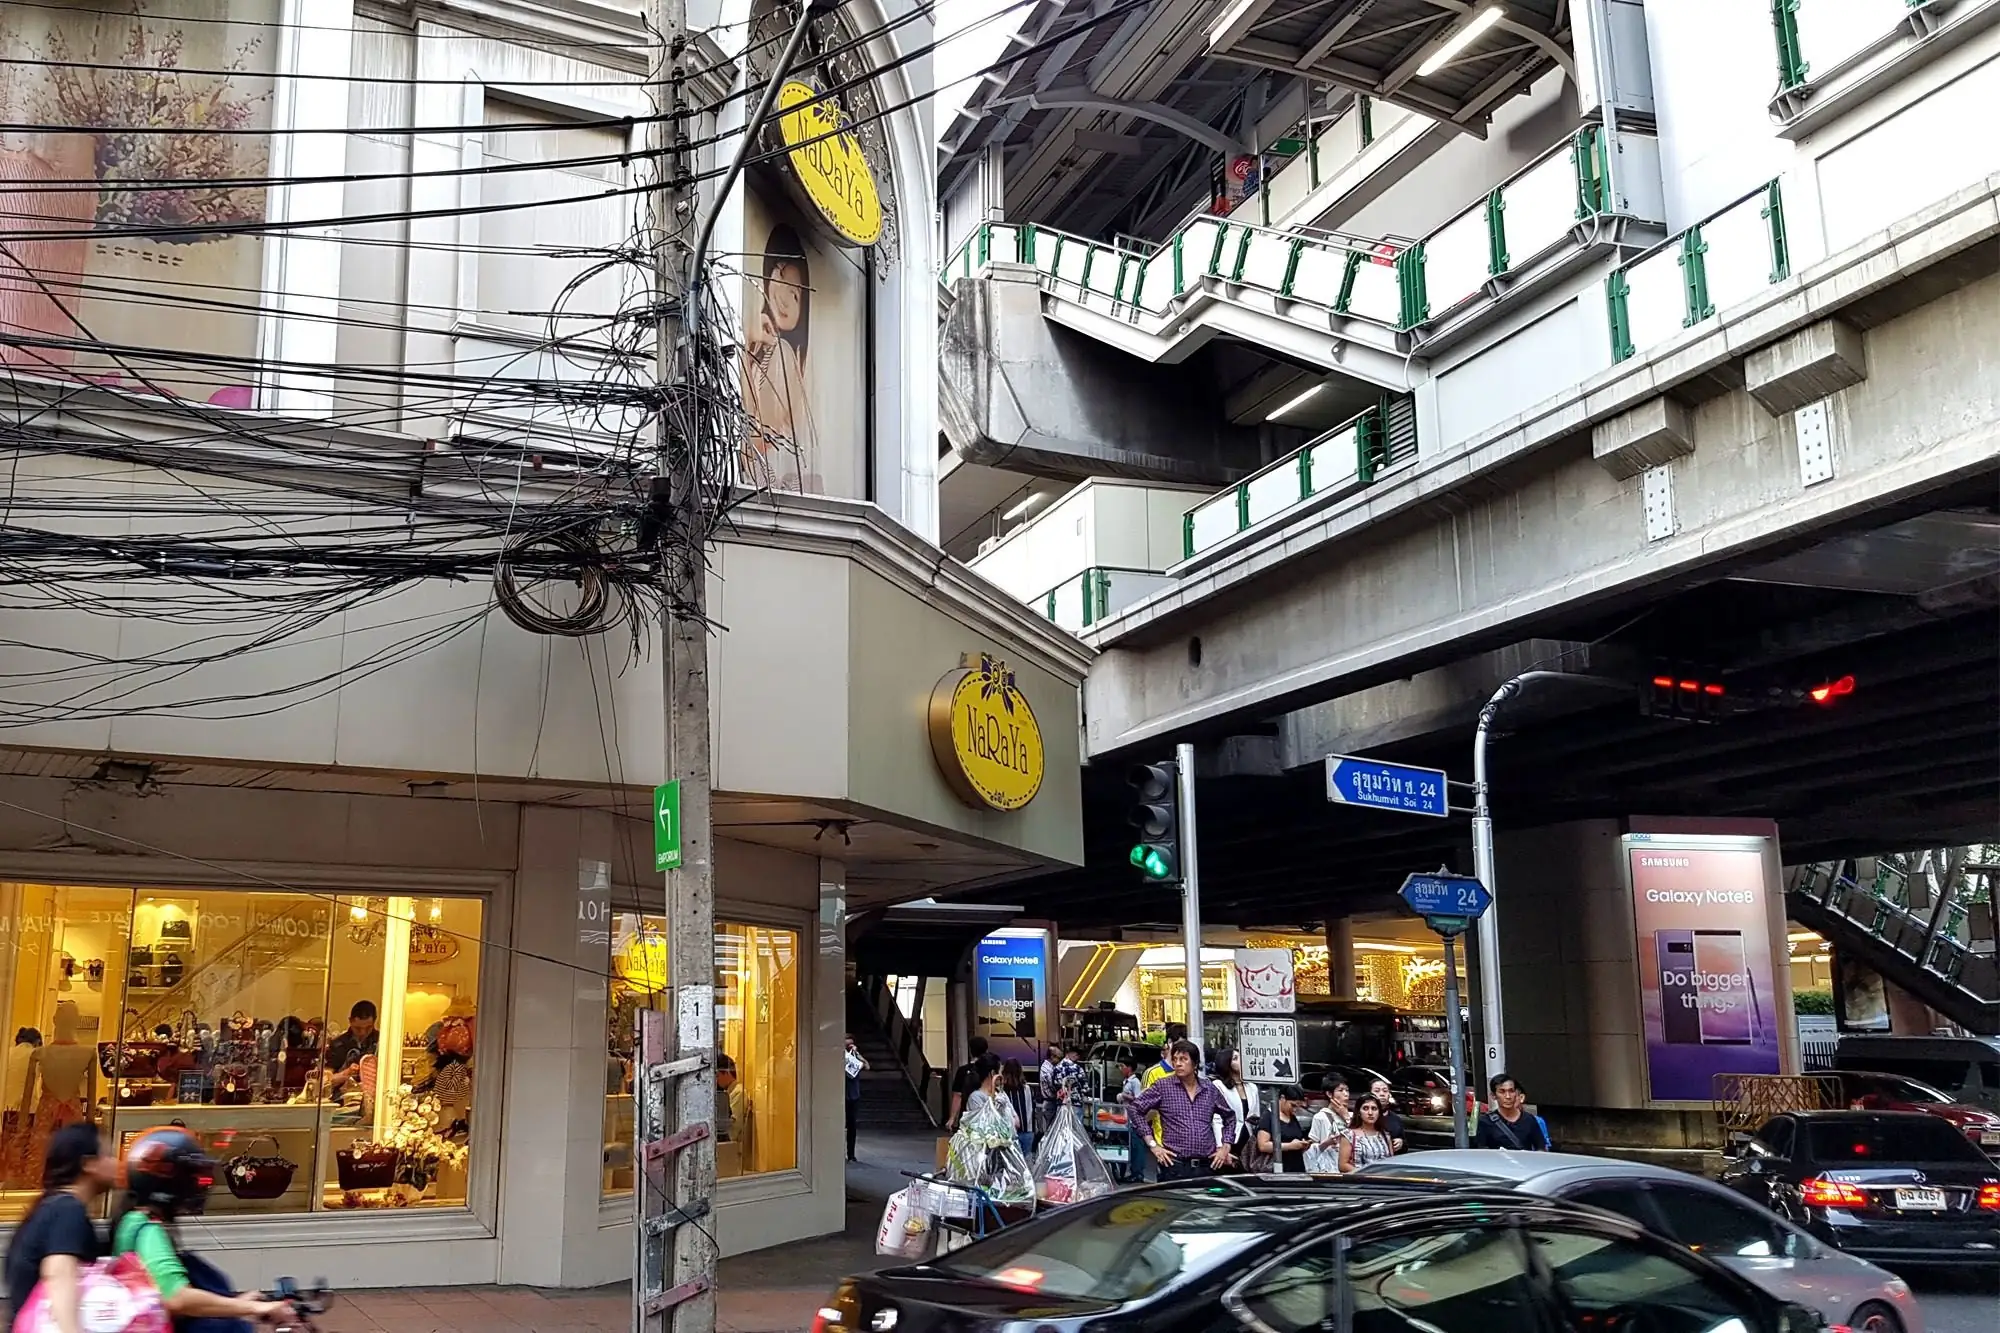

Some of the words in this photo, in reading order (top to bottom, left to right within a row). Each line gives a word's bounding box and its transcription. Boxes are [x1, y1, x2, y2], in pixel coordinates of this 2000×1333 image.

[797, 110, 865, 221] NaRaYa
[966, 703, 1029, 775] NaRaYa
[1352, 769, 1402, 793] สุขุมวิท
[1420, 781, 1437, 798] 24
[1357, 790, 1399, 805] Sukhumvit
[1403, 796, 1417, 808] Soi
[1422, 799, 1433, 810] 24
[1640, 857, 1690, 867] SAMSUNG
[1457, 887, 1479, 907] 24
[1646, 888, 1702, 906] Galaxy
[1706, 889, 1754, 904] Note8
[982, 955, 1012, 966] Galaxy
[1013, 956, 1039, 965] Note8
[1663, 971, 1688, 986] Do
[1690, 970, 1750, 991] bigger
[693, 1002, 700, 1016] 1
[988, 999, 1002, 1007] Do
[1003, 999, 1035, 1010] bigger
[1680, 993, 1736, 1013] things
[997, 1010, 1026, 1021] things
[694, 1026, 700, 1040] 1
[1278, 1025, 1293, 1037] รอ
[1488, 1046, 1497, 1060] 6
